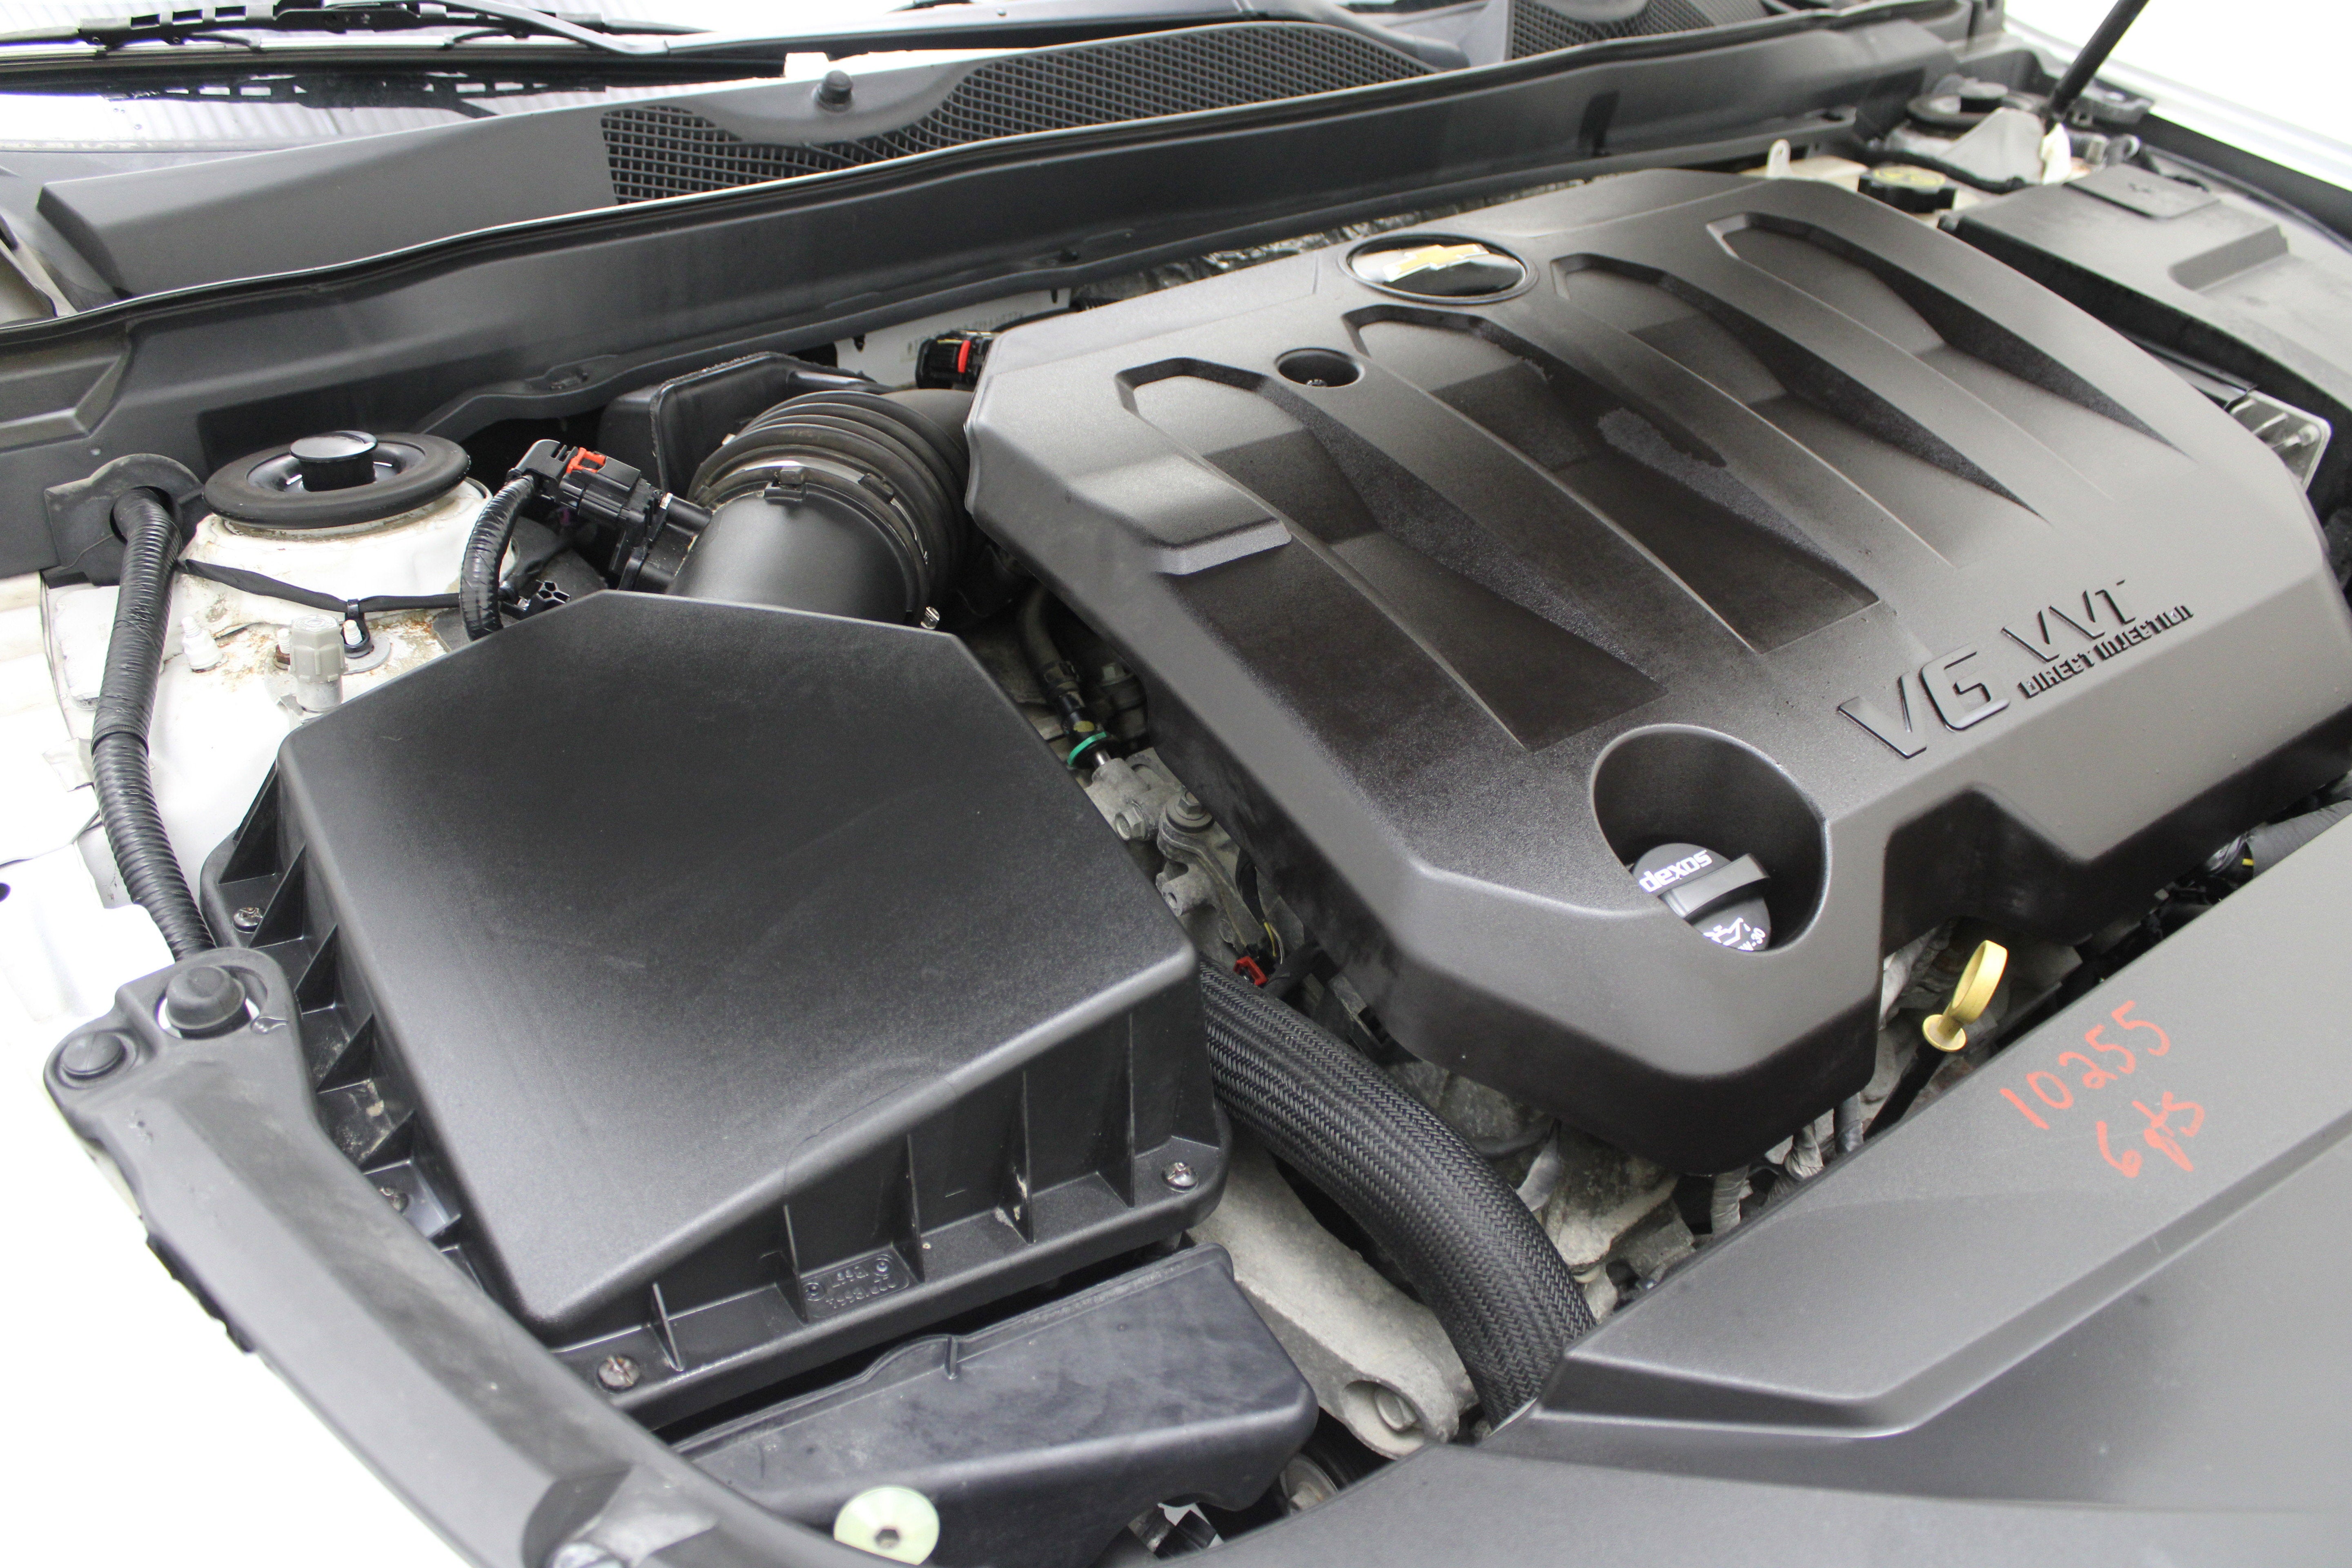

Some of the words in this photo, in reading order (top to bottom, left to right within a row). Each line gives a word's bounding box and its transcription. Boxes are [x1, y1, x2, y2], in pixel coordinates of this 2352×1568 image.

[1838, 642, 2011, 760] V6
[2001, 579, 2136, 665] VVT
[2017, 650, 2096, 699] DIRECT
[2093, 605, 2195, 661] INJECTION
[1639, 849, 1713, 893] dexos
[1737, 927, 1766, 951] W-30
[2000, 1000, 2171, 1130] 10255
[2096, 1120, 2143, 1178] 6
